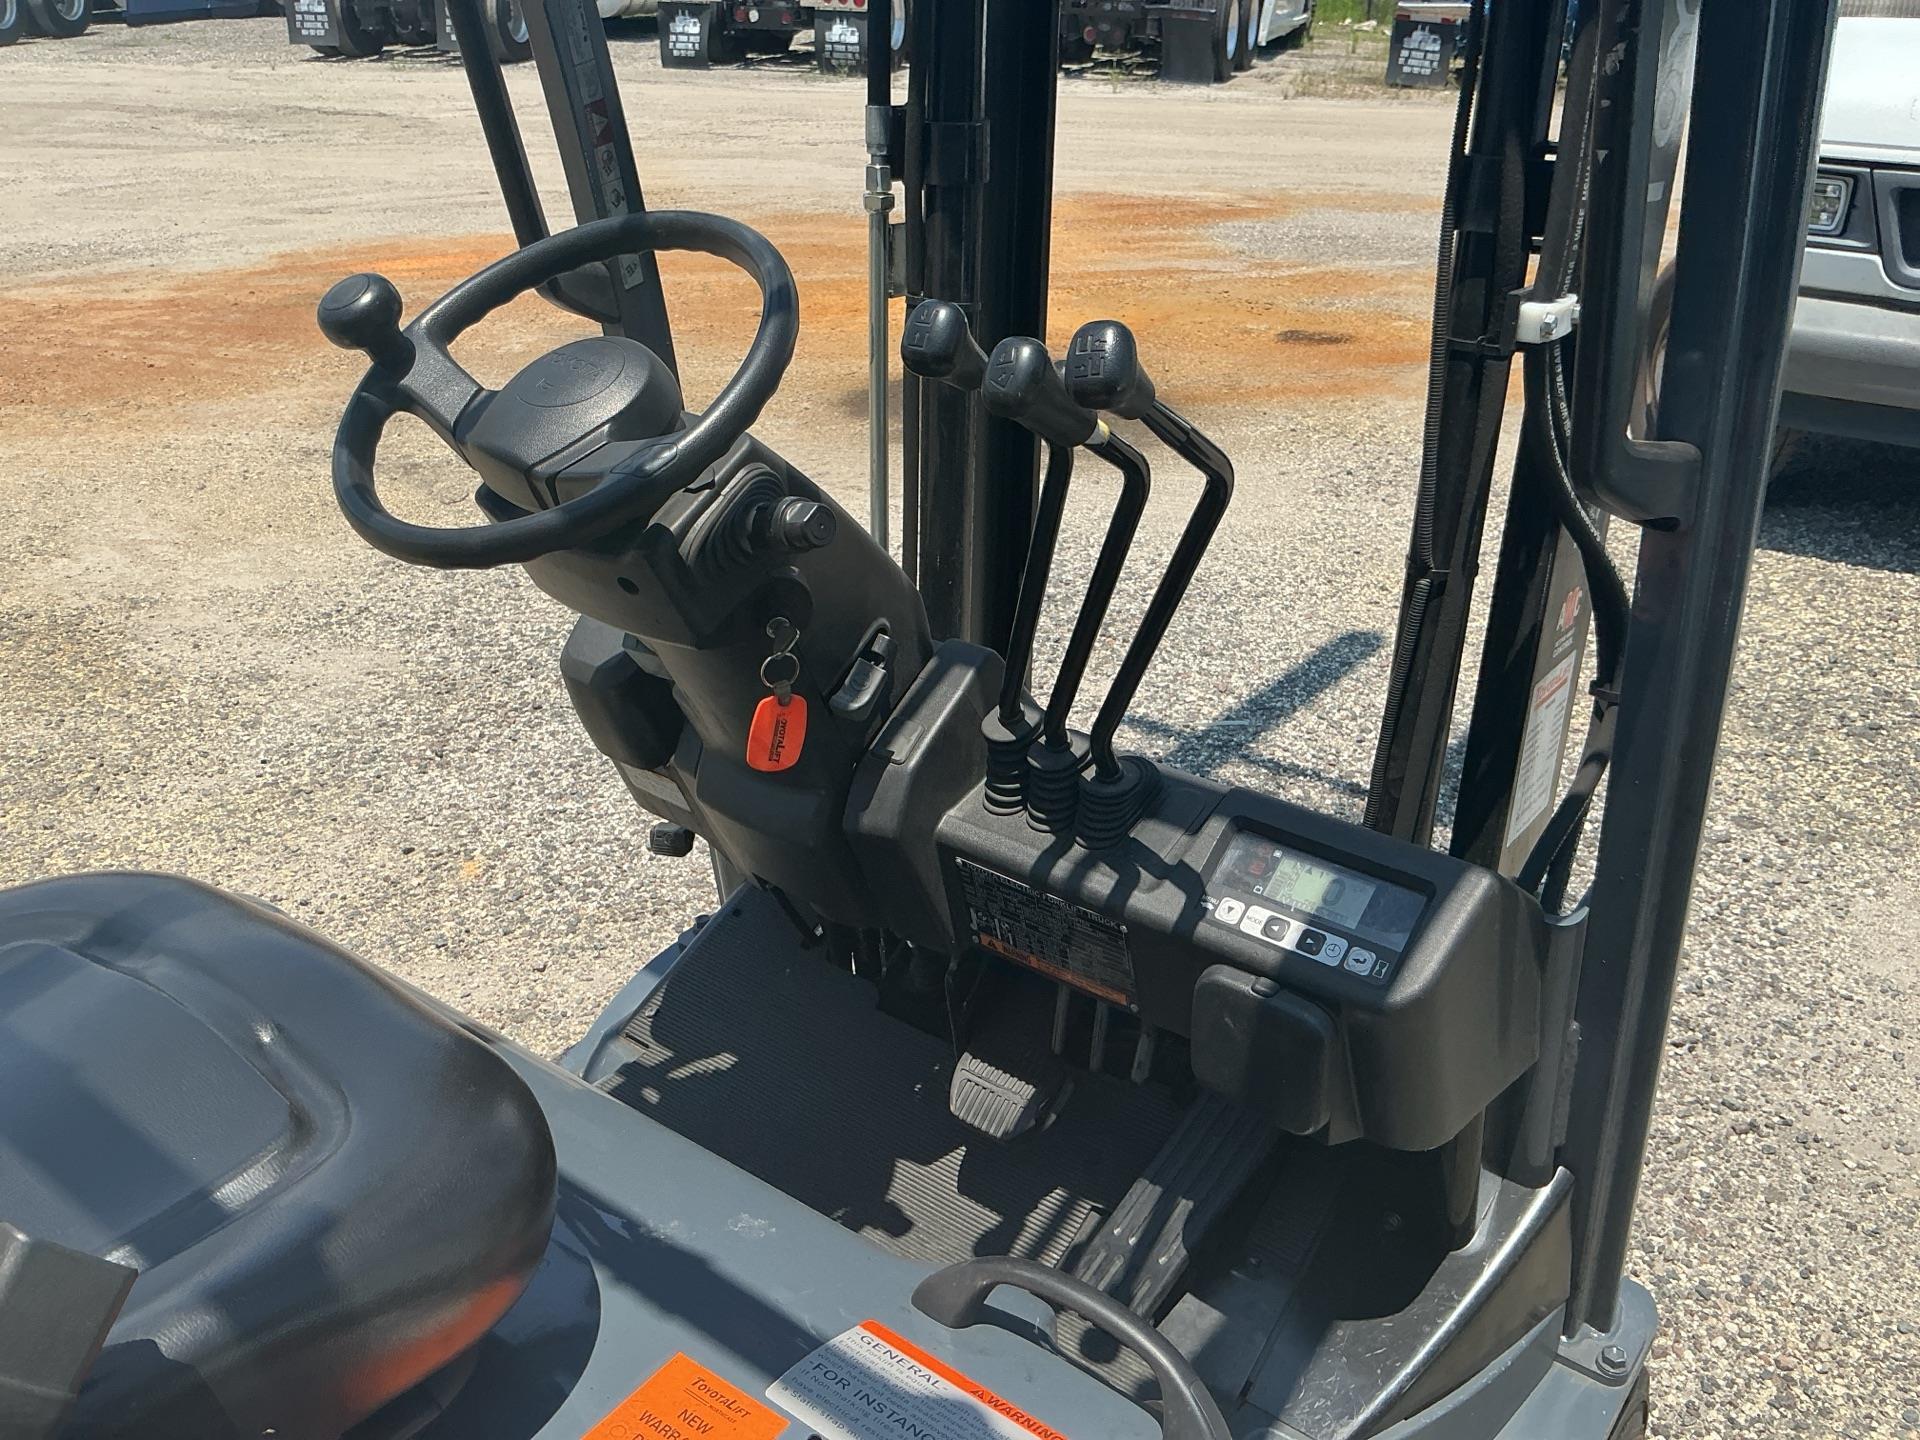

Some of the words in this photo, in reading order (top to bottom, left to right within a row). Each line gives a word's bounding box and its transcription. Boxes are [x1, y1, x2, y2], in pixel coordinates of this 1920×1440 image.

[1001, 878, 1040, 898] ELECTRIC
[1087, 912, 1119, 928] TRUCK
[639, 1410, 689, 1440] WARR
[677, 1409, 714, 1434] NEW
[788, 1389, 820, 1411] Static
[817, 1410, 847, 1430] strap
